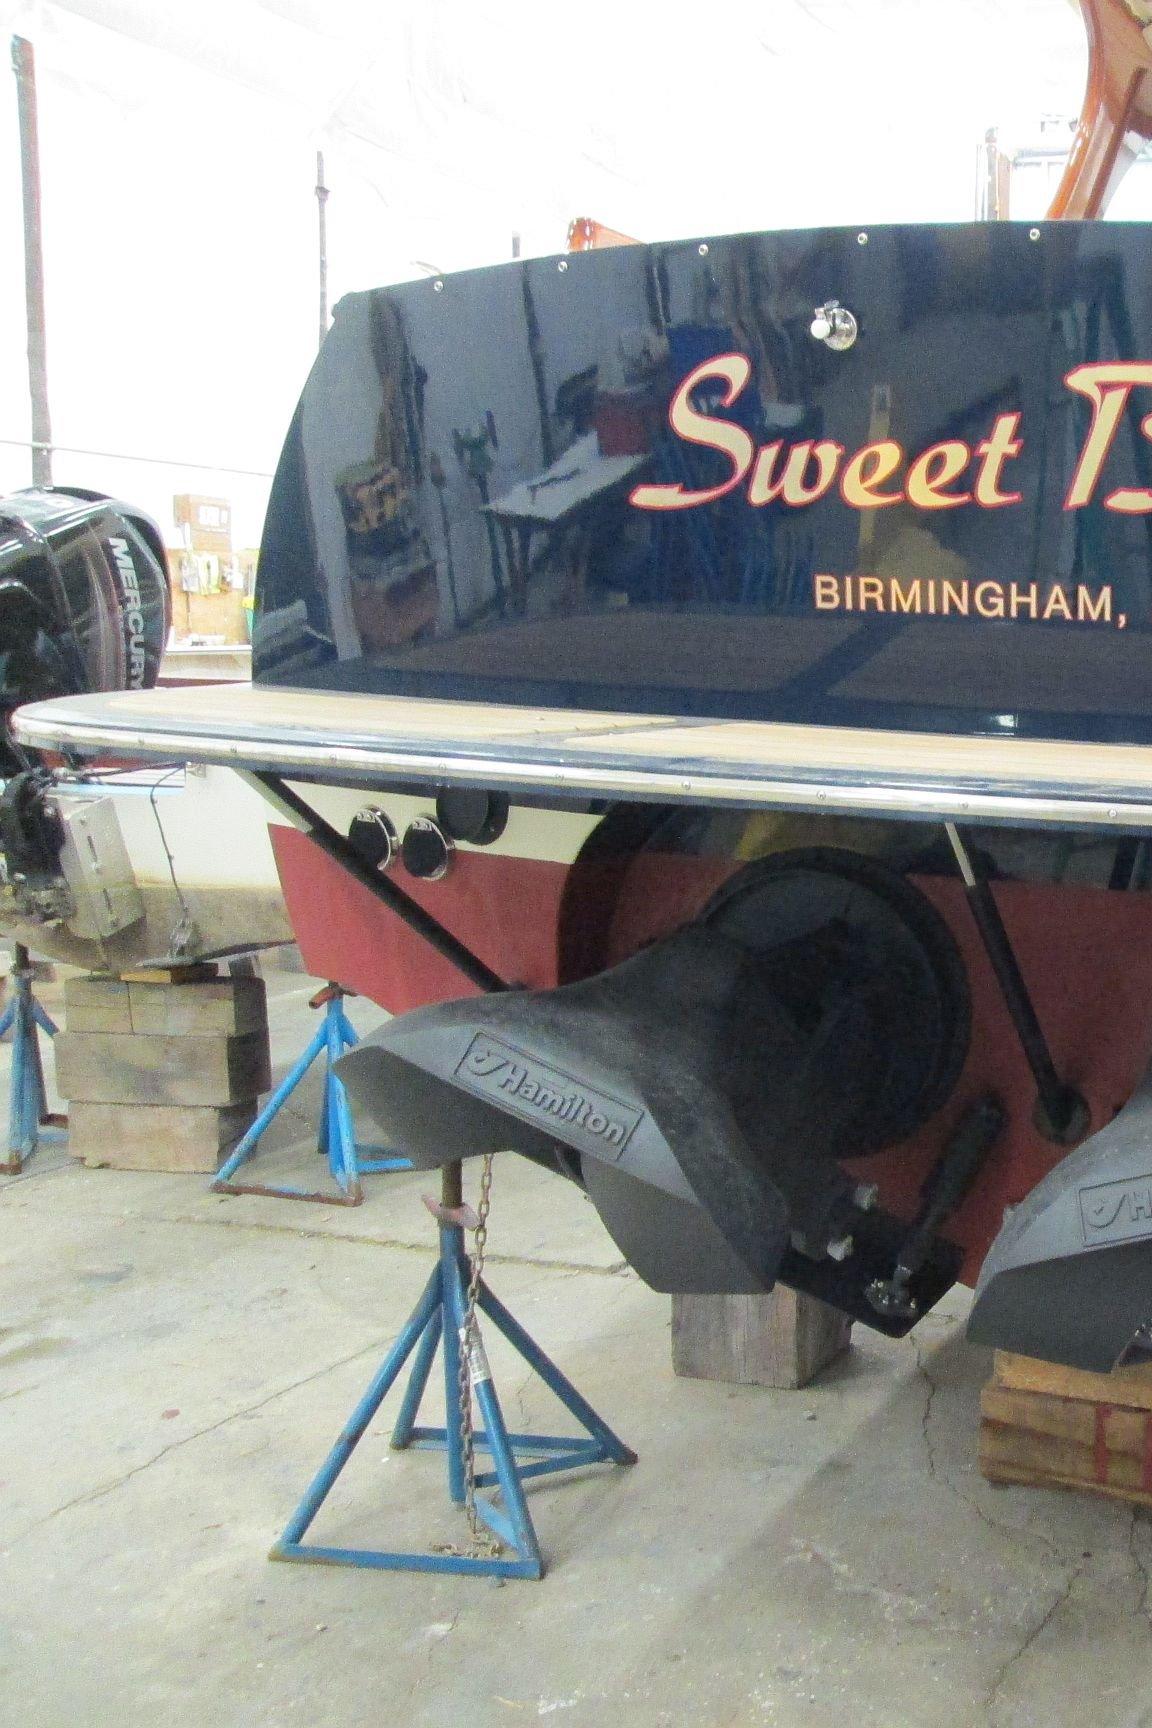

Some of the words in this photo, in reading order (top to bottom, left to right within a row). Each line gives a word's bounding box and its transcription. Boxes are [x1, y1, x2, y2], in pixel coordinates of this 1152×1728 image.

[630, 353, 1022, 510] Sweet
[814, 575, 1126, 628] BIRMINGHAM,
[499, 1063, 627, 1146] Hamilton
